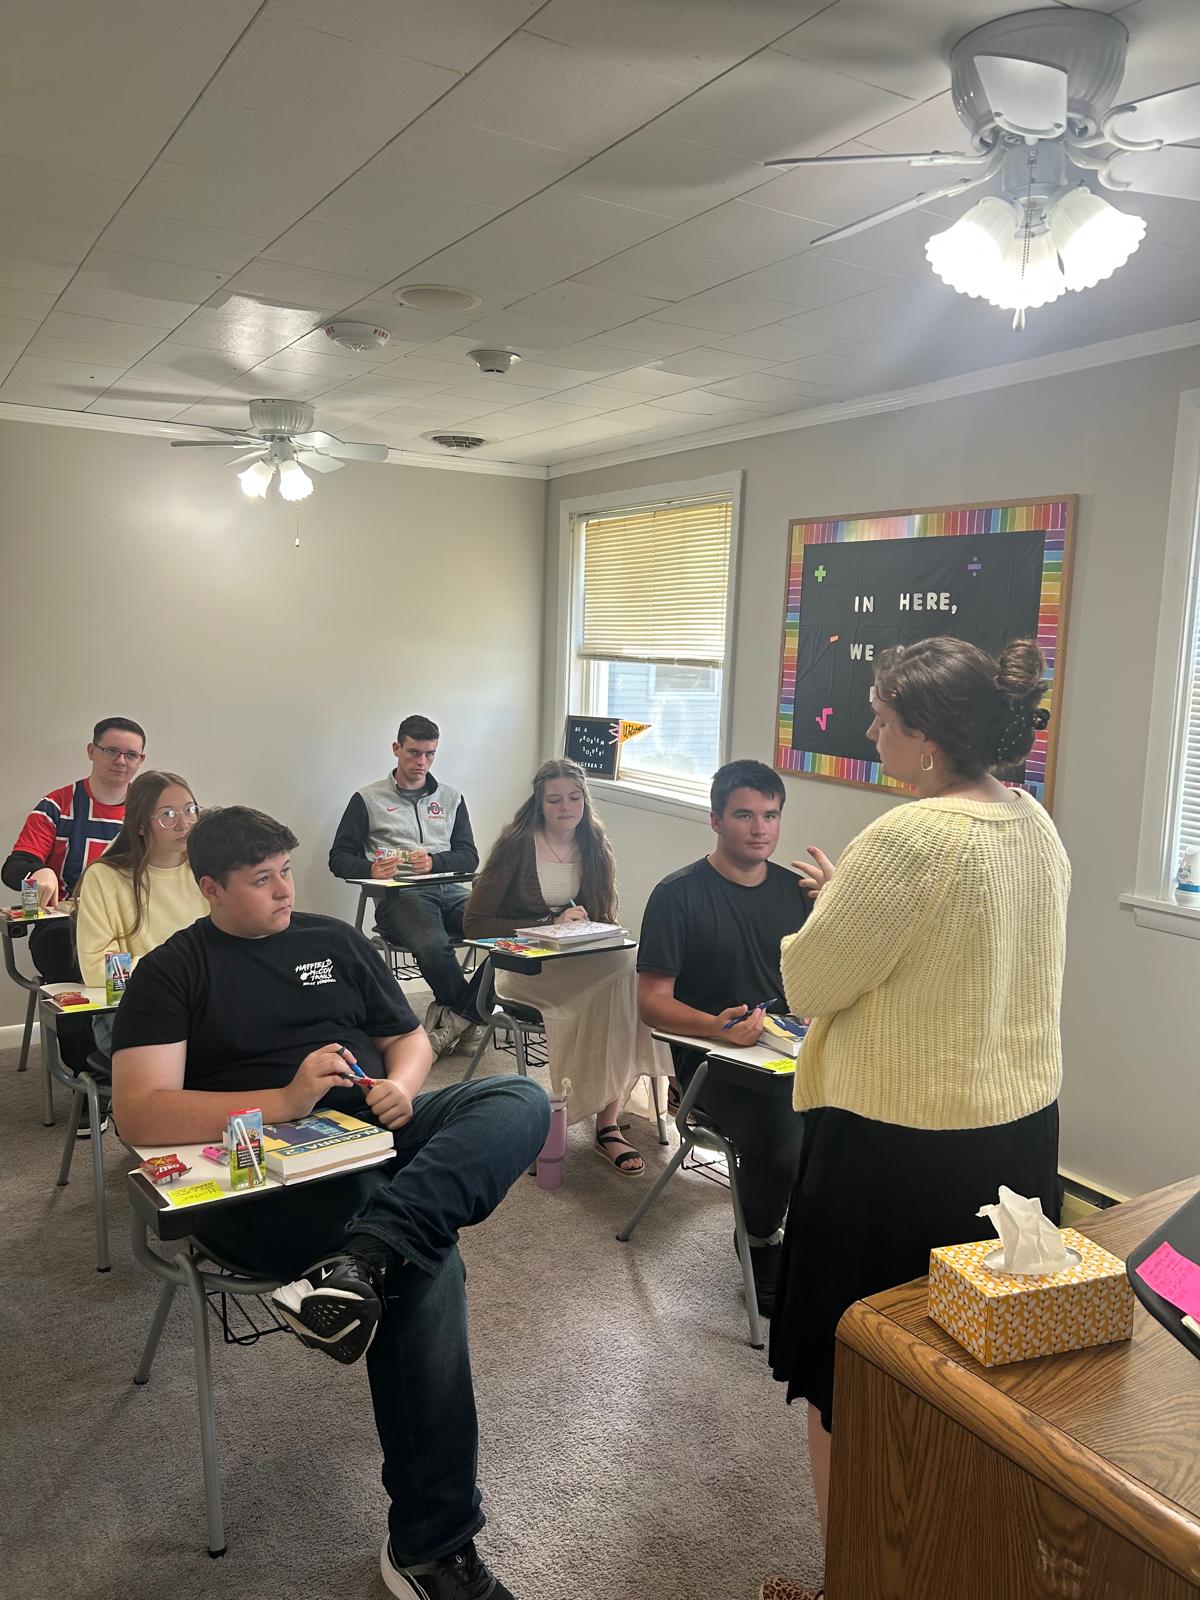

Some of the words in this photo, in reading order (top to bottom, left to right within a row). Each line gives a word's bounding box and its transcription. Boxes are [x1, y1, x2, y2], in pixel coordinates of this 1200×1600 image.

[854, 595, 874, 613] IN
[899, 592, 957, 615] HERE,
[849, 643, 874, 661] WE
[579, 736, 604, 745] PROBLEM
[295, 958, 332, 972] HATFIELD
[306, 1127, 380, 1149] ALGEBRA
